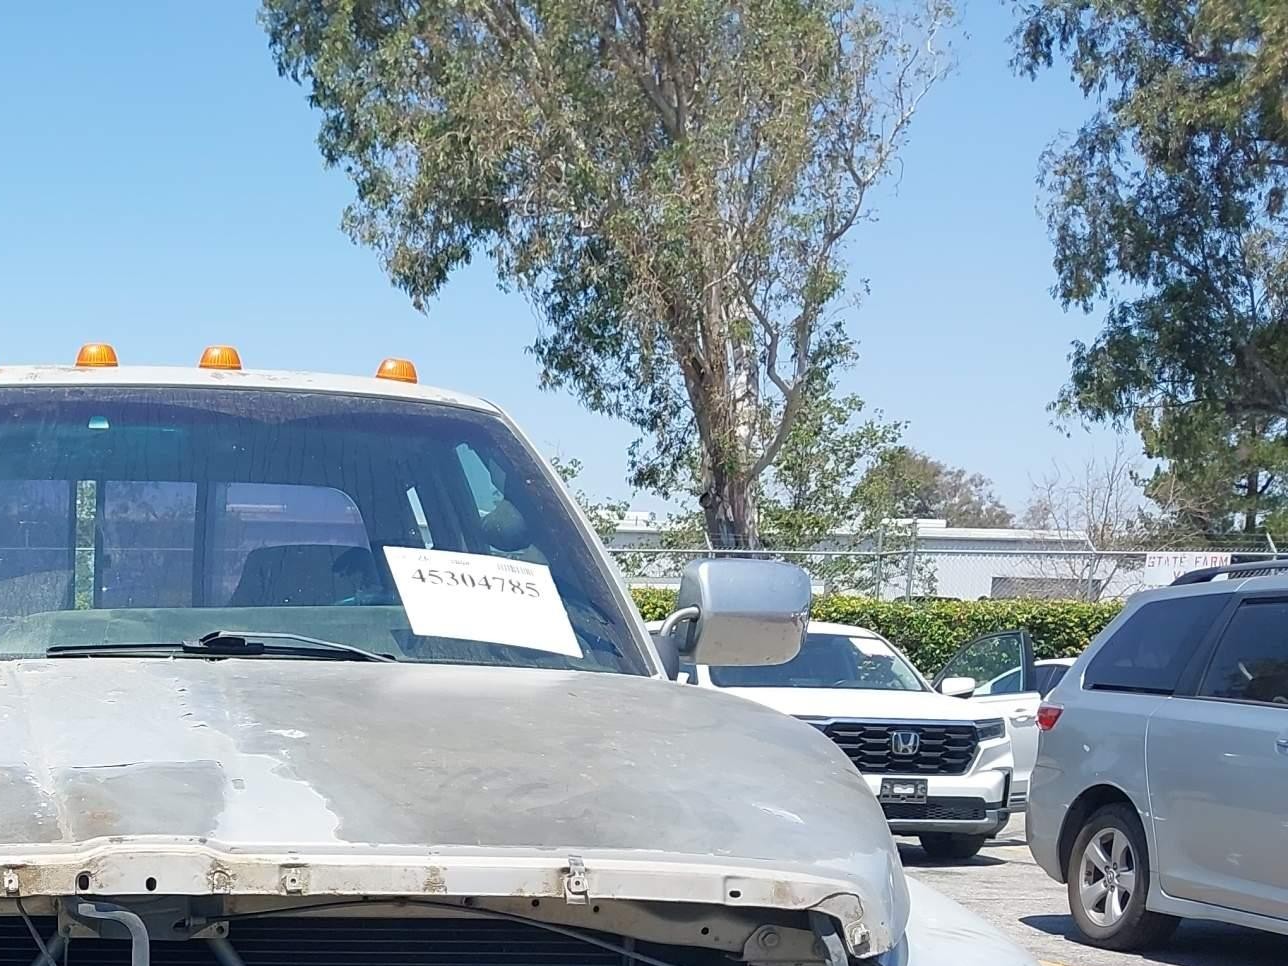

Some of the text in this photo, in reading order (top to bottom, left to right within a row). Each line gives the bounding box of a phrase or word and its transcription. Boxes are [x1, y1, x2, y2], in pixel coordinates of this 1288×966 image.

[1148, 555, 1229, 568] STATE FARM
[412, 568, 540, 597] 45304785
